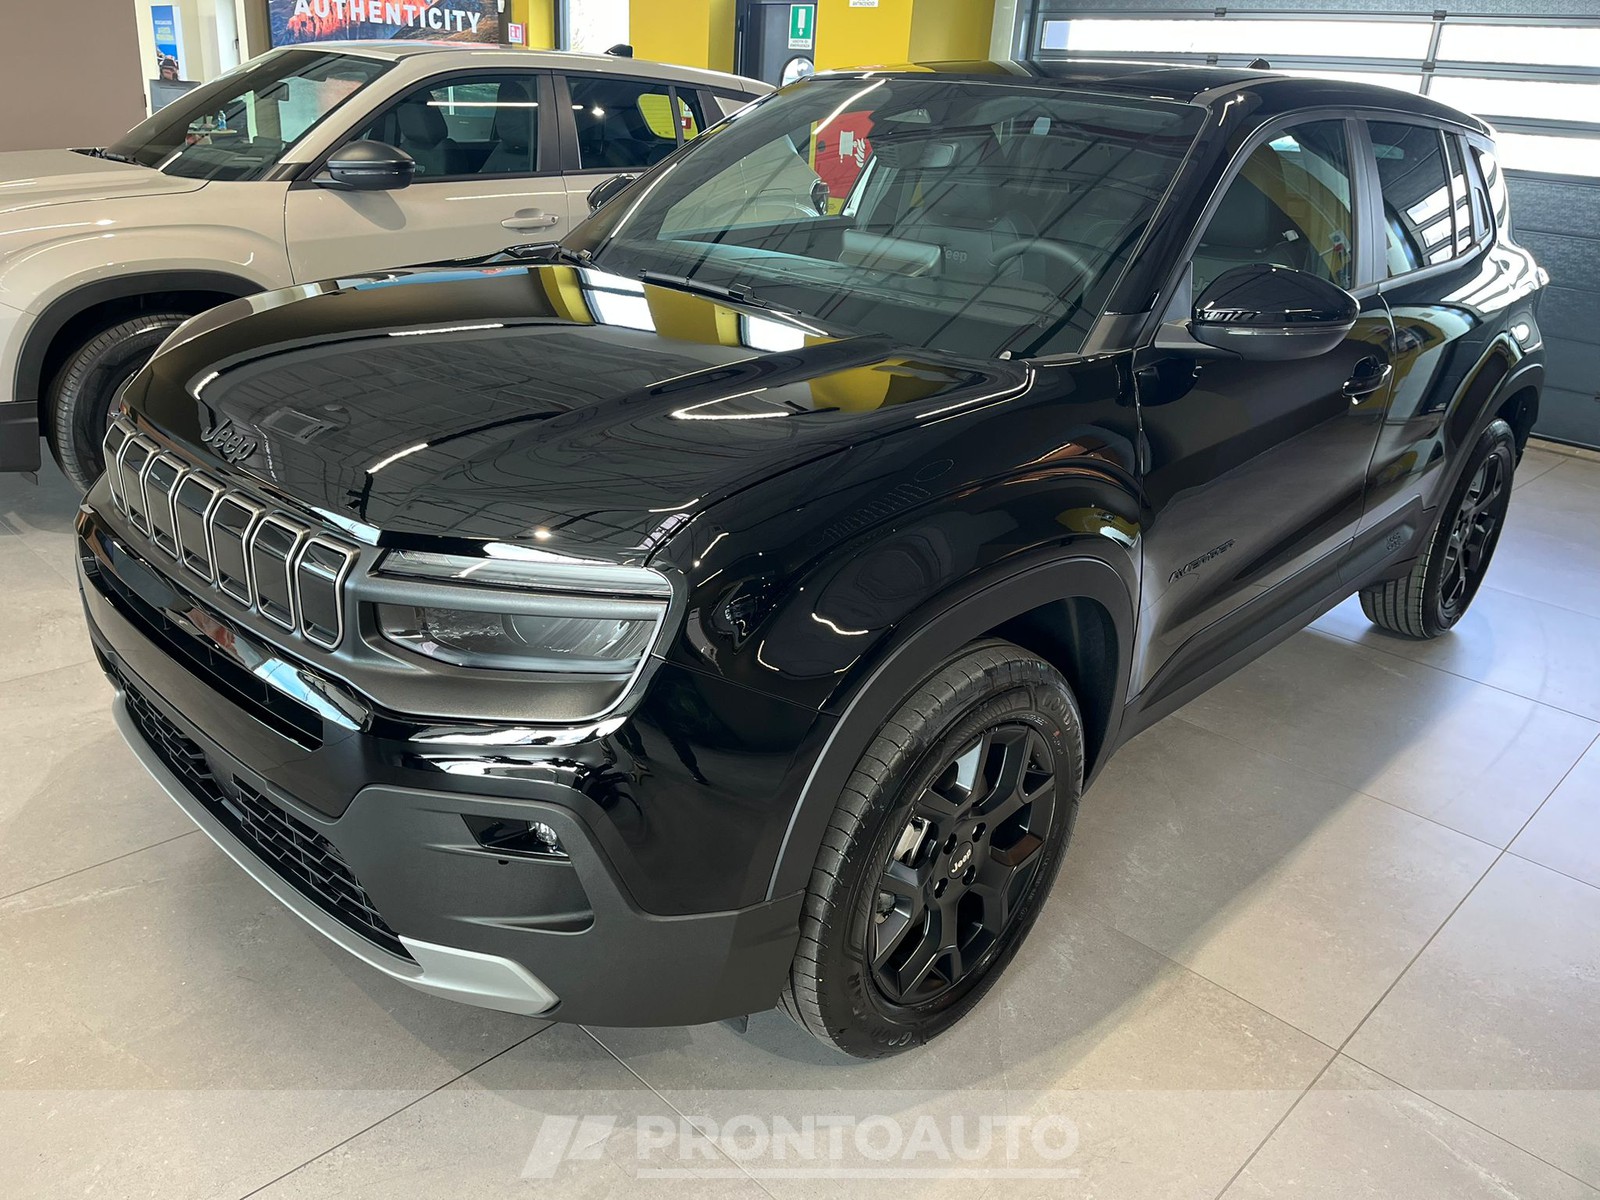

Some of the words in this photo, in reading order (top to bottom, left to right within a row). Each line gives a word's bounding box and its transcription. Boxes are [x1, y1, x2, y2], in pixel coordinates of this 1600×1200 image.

[293, 0, 481, 34] AUTHENTICITY
[200, 418, 257, 464] Jeep
[951, 848, 972, 873] Jeep
